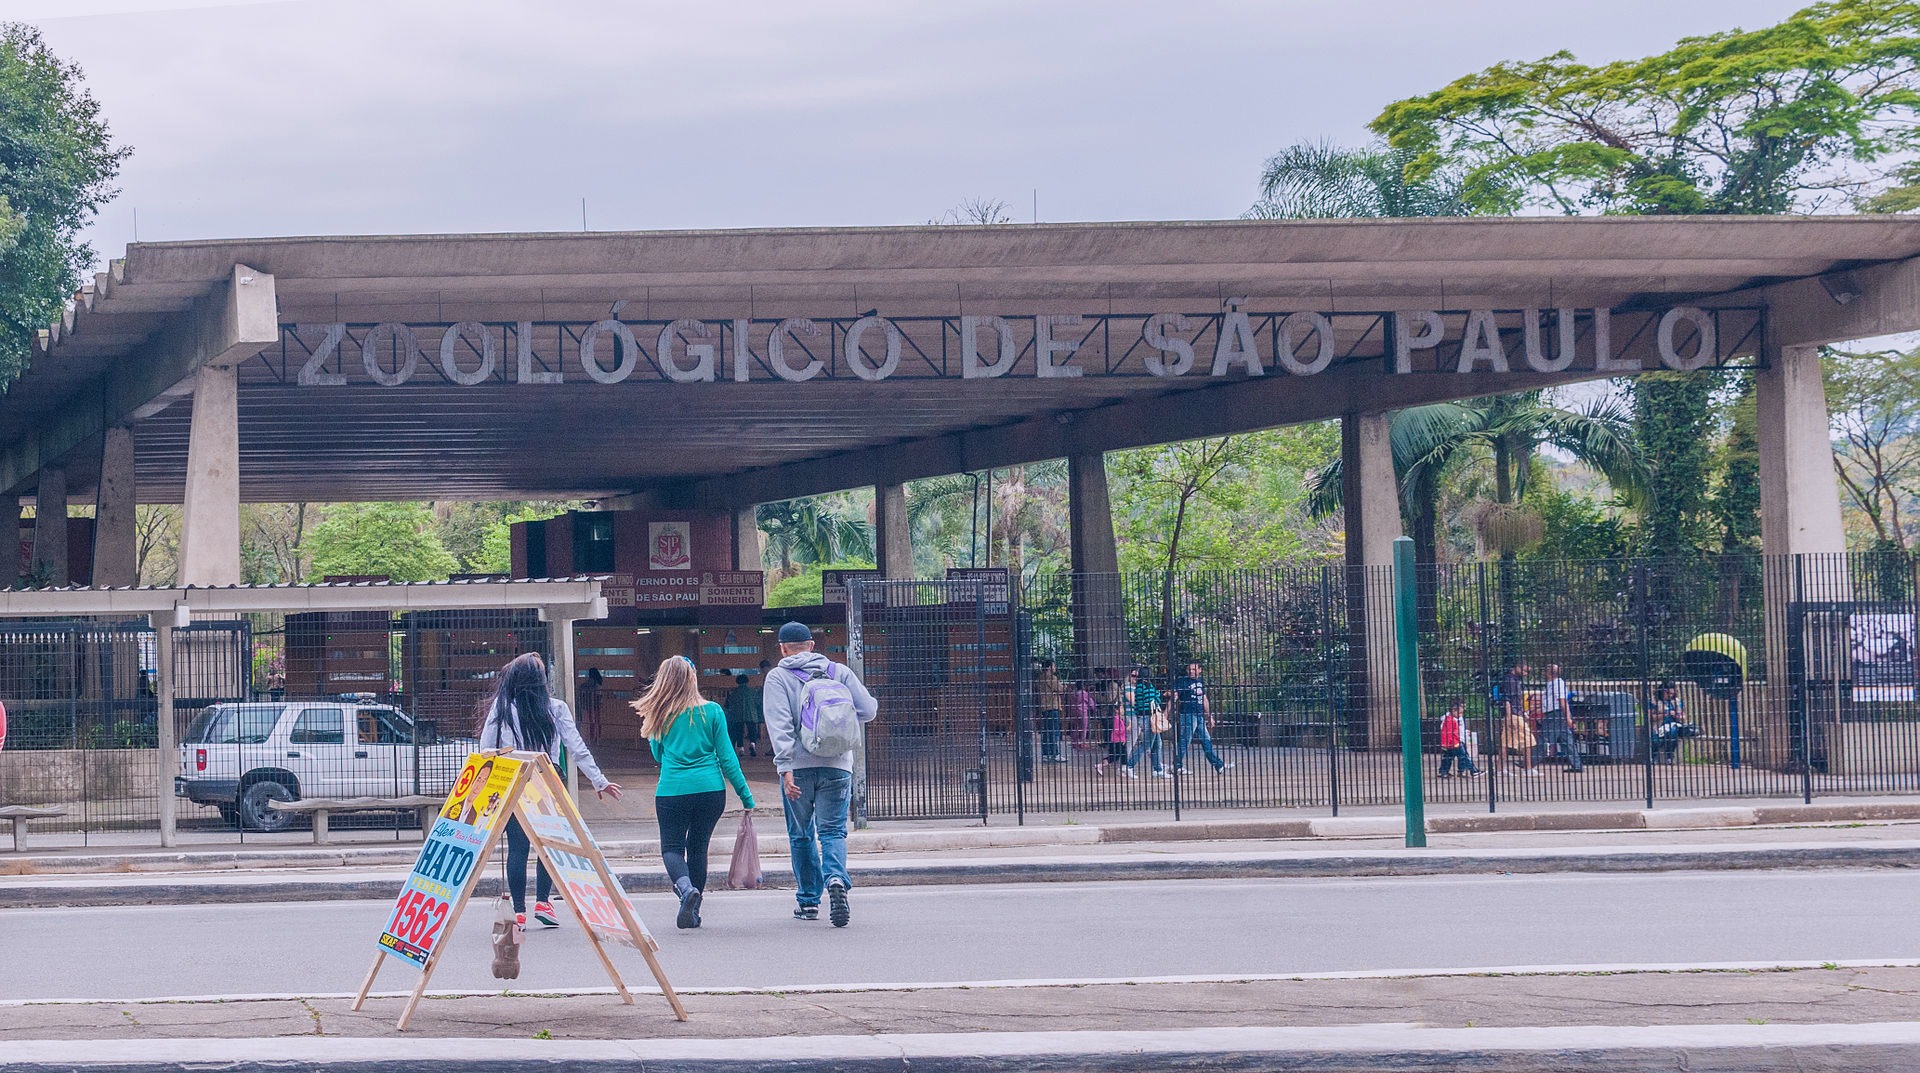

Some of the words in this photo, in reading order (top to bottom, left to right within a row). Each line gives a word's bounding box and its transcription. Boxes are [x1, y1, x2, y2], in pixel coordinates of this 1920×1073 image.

[297, 300, 901, 386] ZOOLÓGICO
[962, 315, 1083, 378] DE
[1143, 296, 1335, 377] SÃO
[1395, 306, 1717, 374] PAULO
[669, 577, 684, 586] DO
[636, 593, 650, 602] DE
[651, 591, 673, 602] SÃO
[707, 588, 755, 596] SOMENTE
[707, 596, 755, 604] DINHEIRO
[430, 821, 455, 838] Alex
[413, 838, 475, 888] HATO
[411, 875, 453, 900] FEDERAL
[388, 888, 450, 951] 1562
